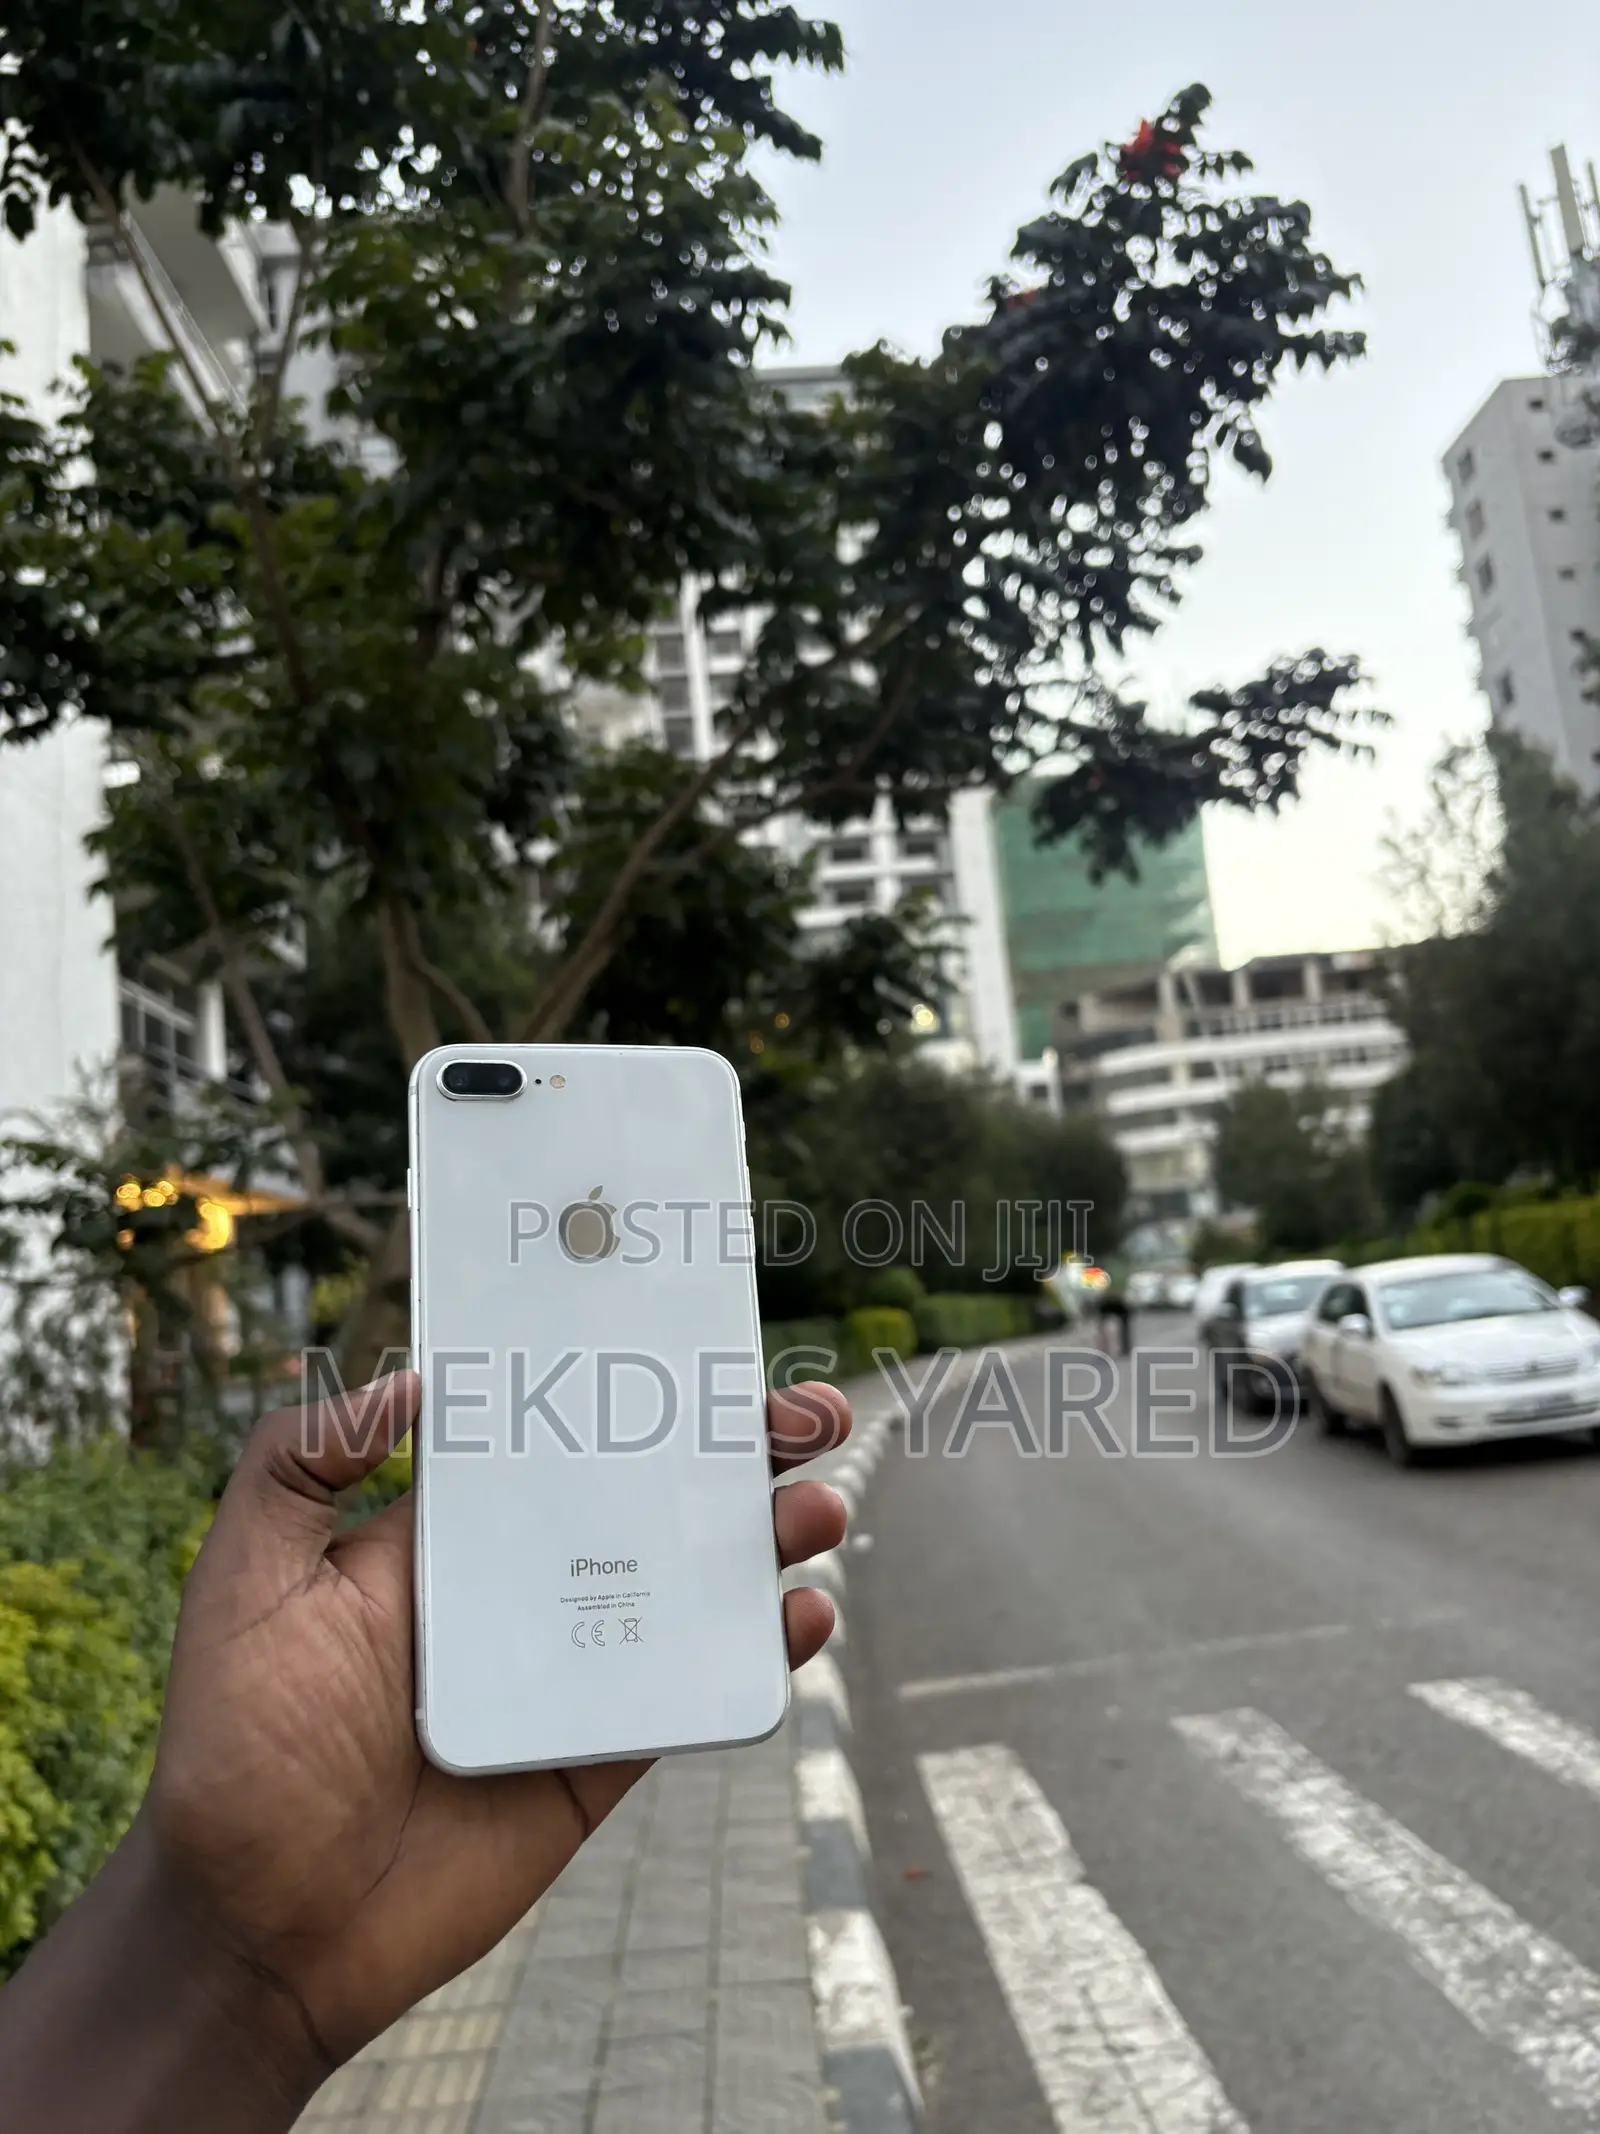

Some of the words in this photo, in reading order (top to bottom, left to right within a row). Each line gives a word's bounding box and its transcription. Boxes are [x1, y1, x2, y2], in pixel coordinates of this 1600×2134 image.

[570, 1558, 638, 1577] iPhone
[560, 1595, 589, 1604] Designed
[577, 1602, 610, 1611] Assembled
[617, 1601, 636, 1609] China
[571, 1619, 606, 1648] CE
